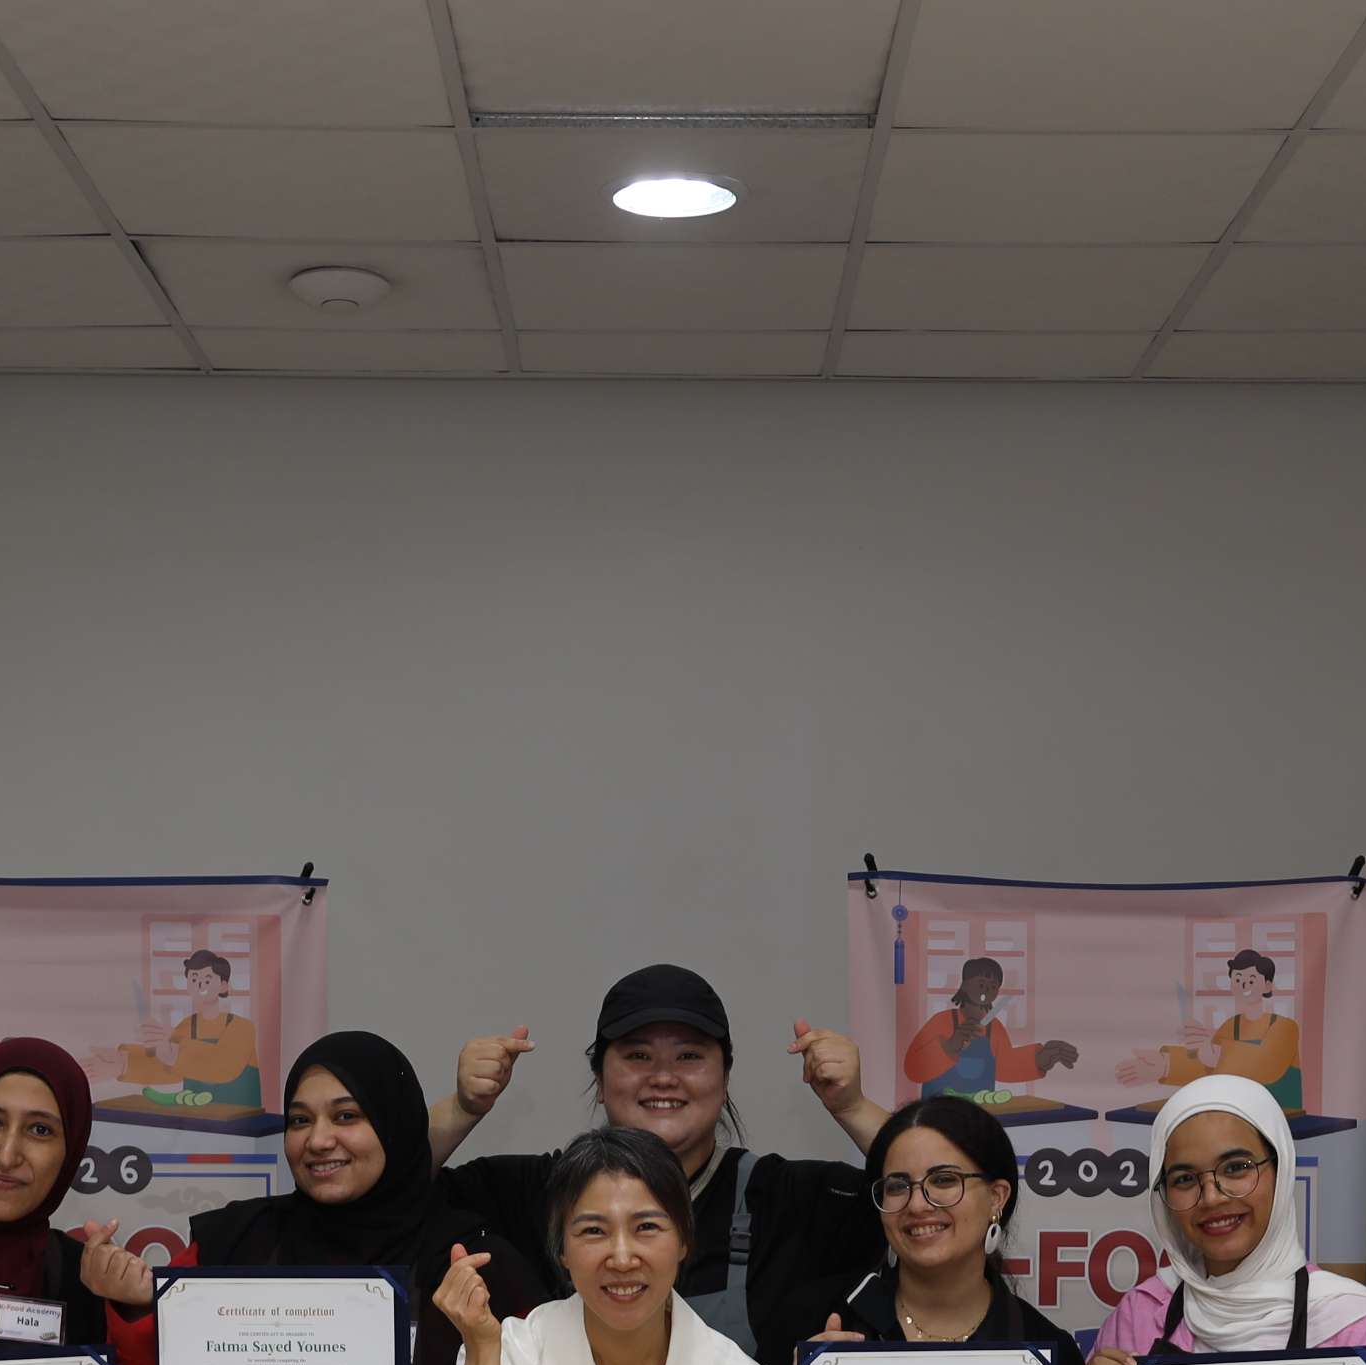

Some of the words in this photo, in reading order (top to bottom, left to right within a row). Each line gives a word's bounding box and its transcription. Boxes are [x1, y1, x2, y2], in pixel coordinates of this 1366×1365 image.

[79, 1154, 139, 1185] 26
[1037, 1159, 1139, 1187] 202
[1002, 1229, 1172, 1308] -FO
[17, 1316, 39, 1327] Hala
[217, 1305, 267, 1317] Certificate
[271, 1306, 280, 1316] of
[285, 1305, 334, 1317] completion
[205, 1340, 247, 1352] Fatma
[252, 1340, 291, 1356] Sayed
[297, 1340, 347, 1352] Younes
